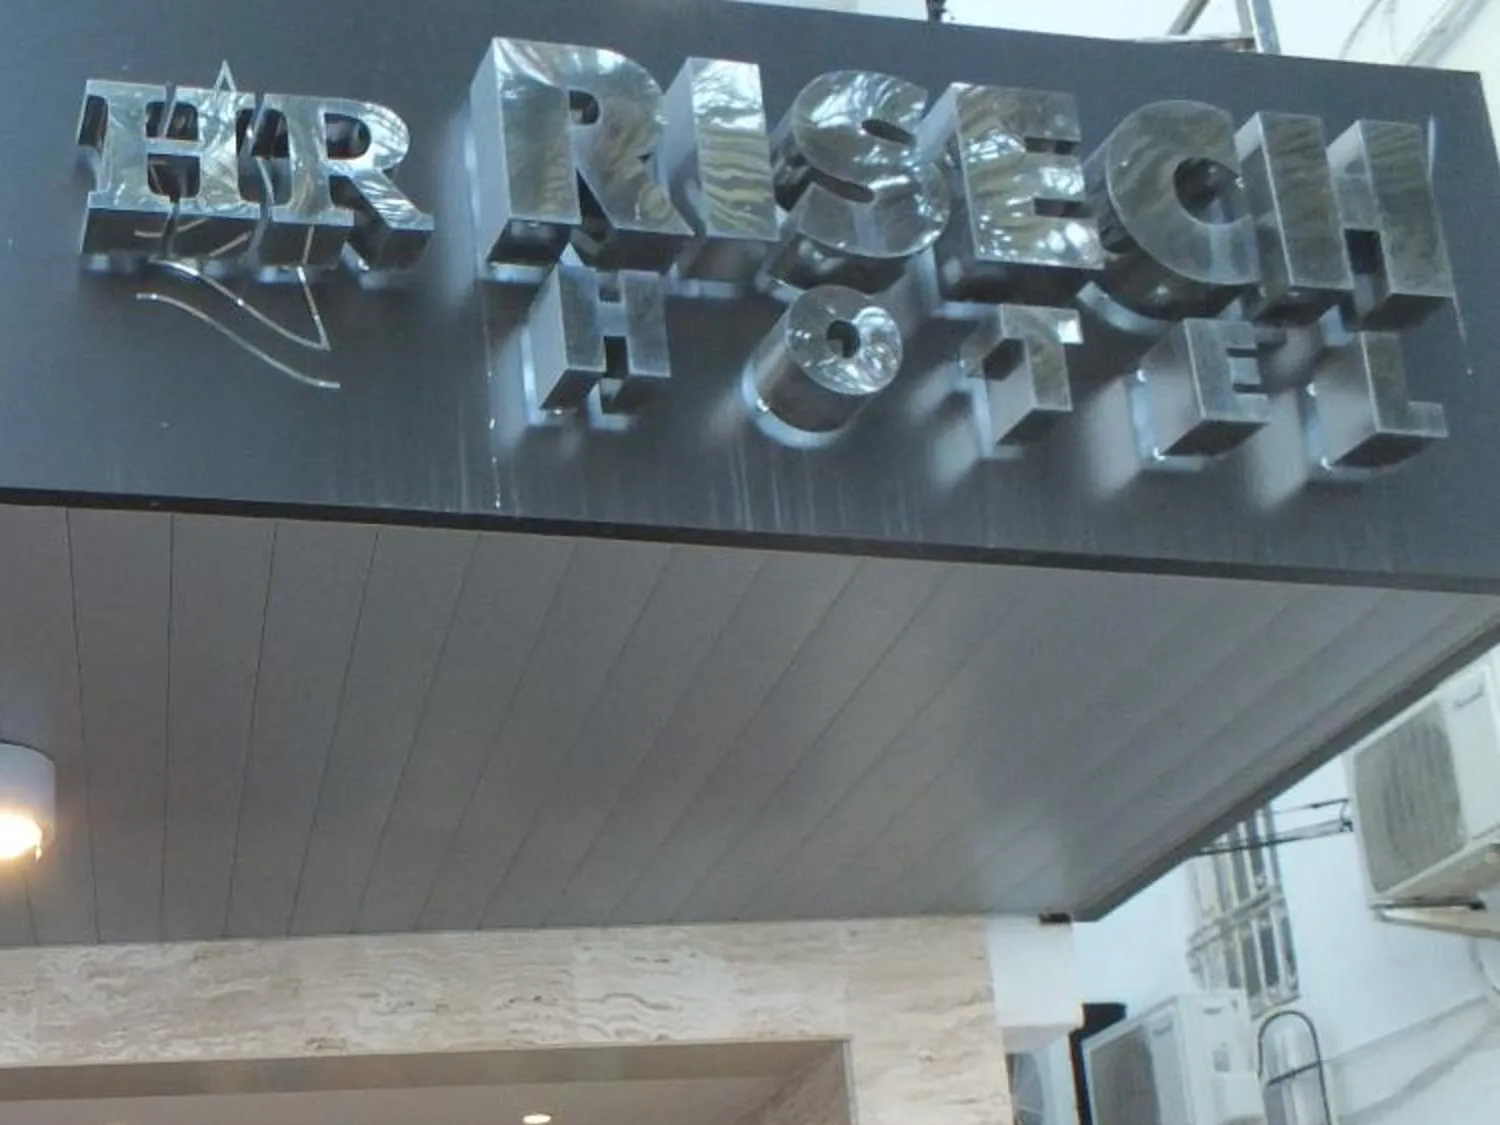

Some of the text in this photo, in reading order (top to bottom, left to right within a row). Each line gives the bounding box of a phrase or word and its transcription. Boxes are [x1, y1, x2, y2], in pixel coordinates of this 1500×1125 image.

[78, 77, 434, 270] HR
[471, 37, 1453, 330] RISECH
[539, 264, 1448, 470] HOTEL
